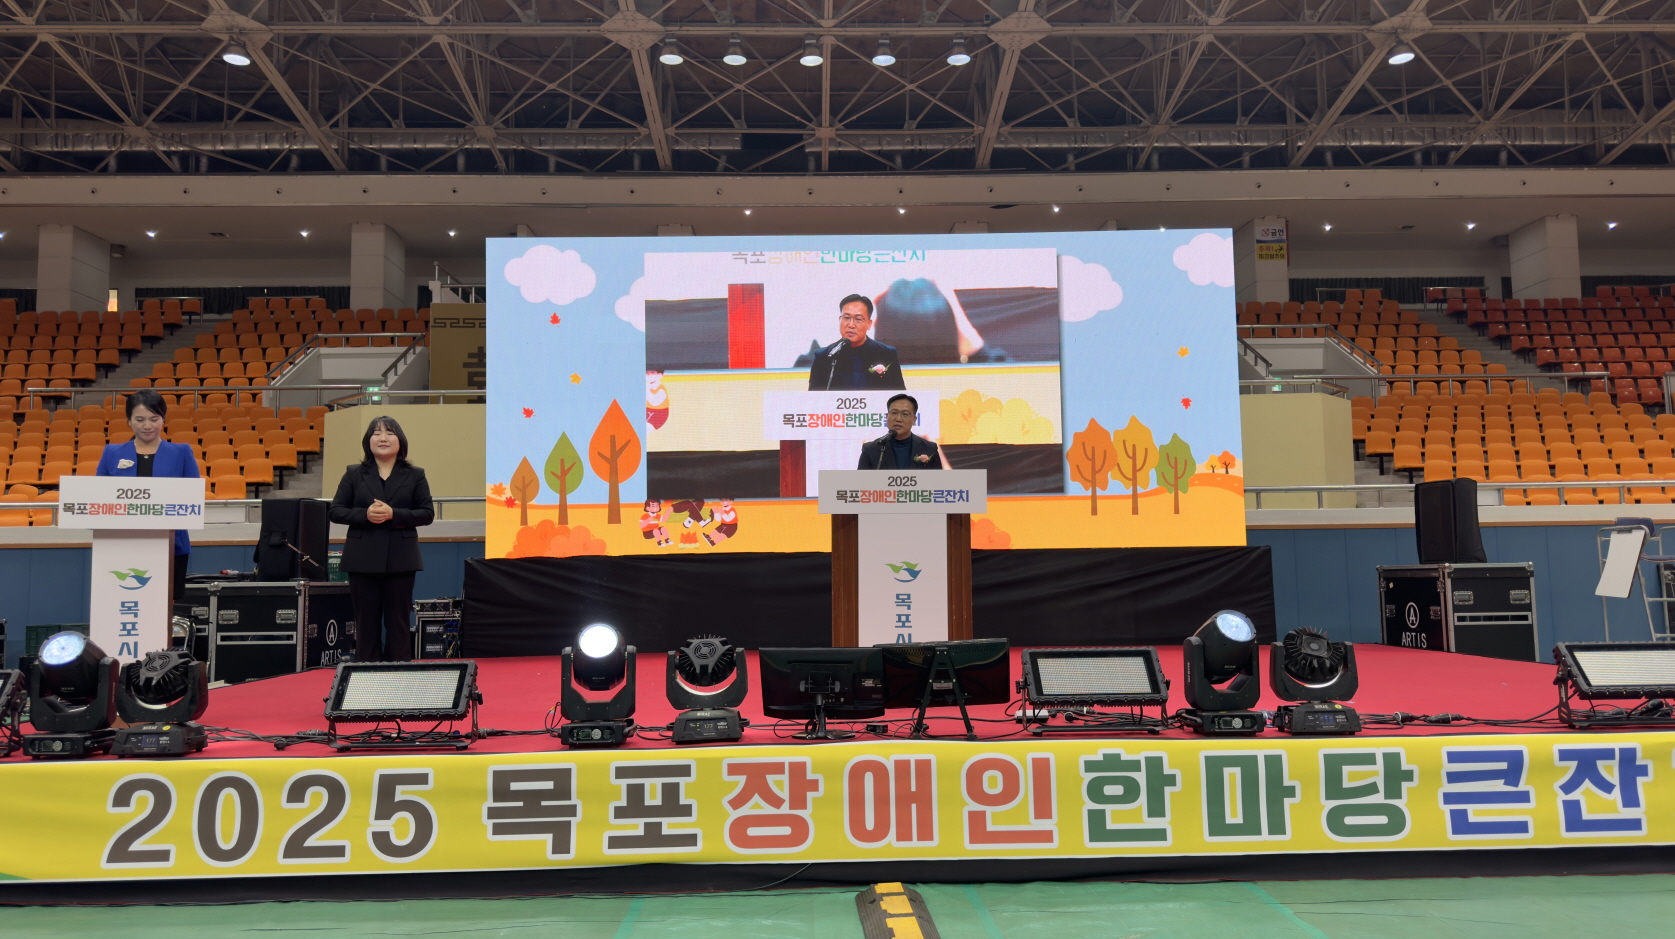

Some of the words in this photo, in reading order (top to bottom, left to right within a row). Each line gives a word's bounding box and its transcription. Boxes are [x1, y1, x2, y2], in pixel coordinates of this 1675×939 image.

[1270, 228, 1284, 236] 금연
[836, 398, 867, 410] 2025
[782, 413, 920, 428] 목포장애인한마당
[887, 476, 917, 487] 2025
[116, 488, 151, 500] 2025
[836, 490, 970, 504] 목포장애인한마당큰잔치
[62, 502, 202, 516] 목포장애인한마당큰잔치
[894, 593, 912, 644] 목포시
[118, 600, 140, 658] 목포시
[1402, 632, 1427, 648] ARTIS
[320, 648, 342, 667] ARTIS
[101, 768, 439, 869] 2025
[482, 744, 1675, 860] 목포장애인한마당큰잔
